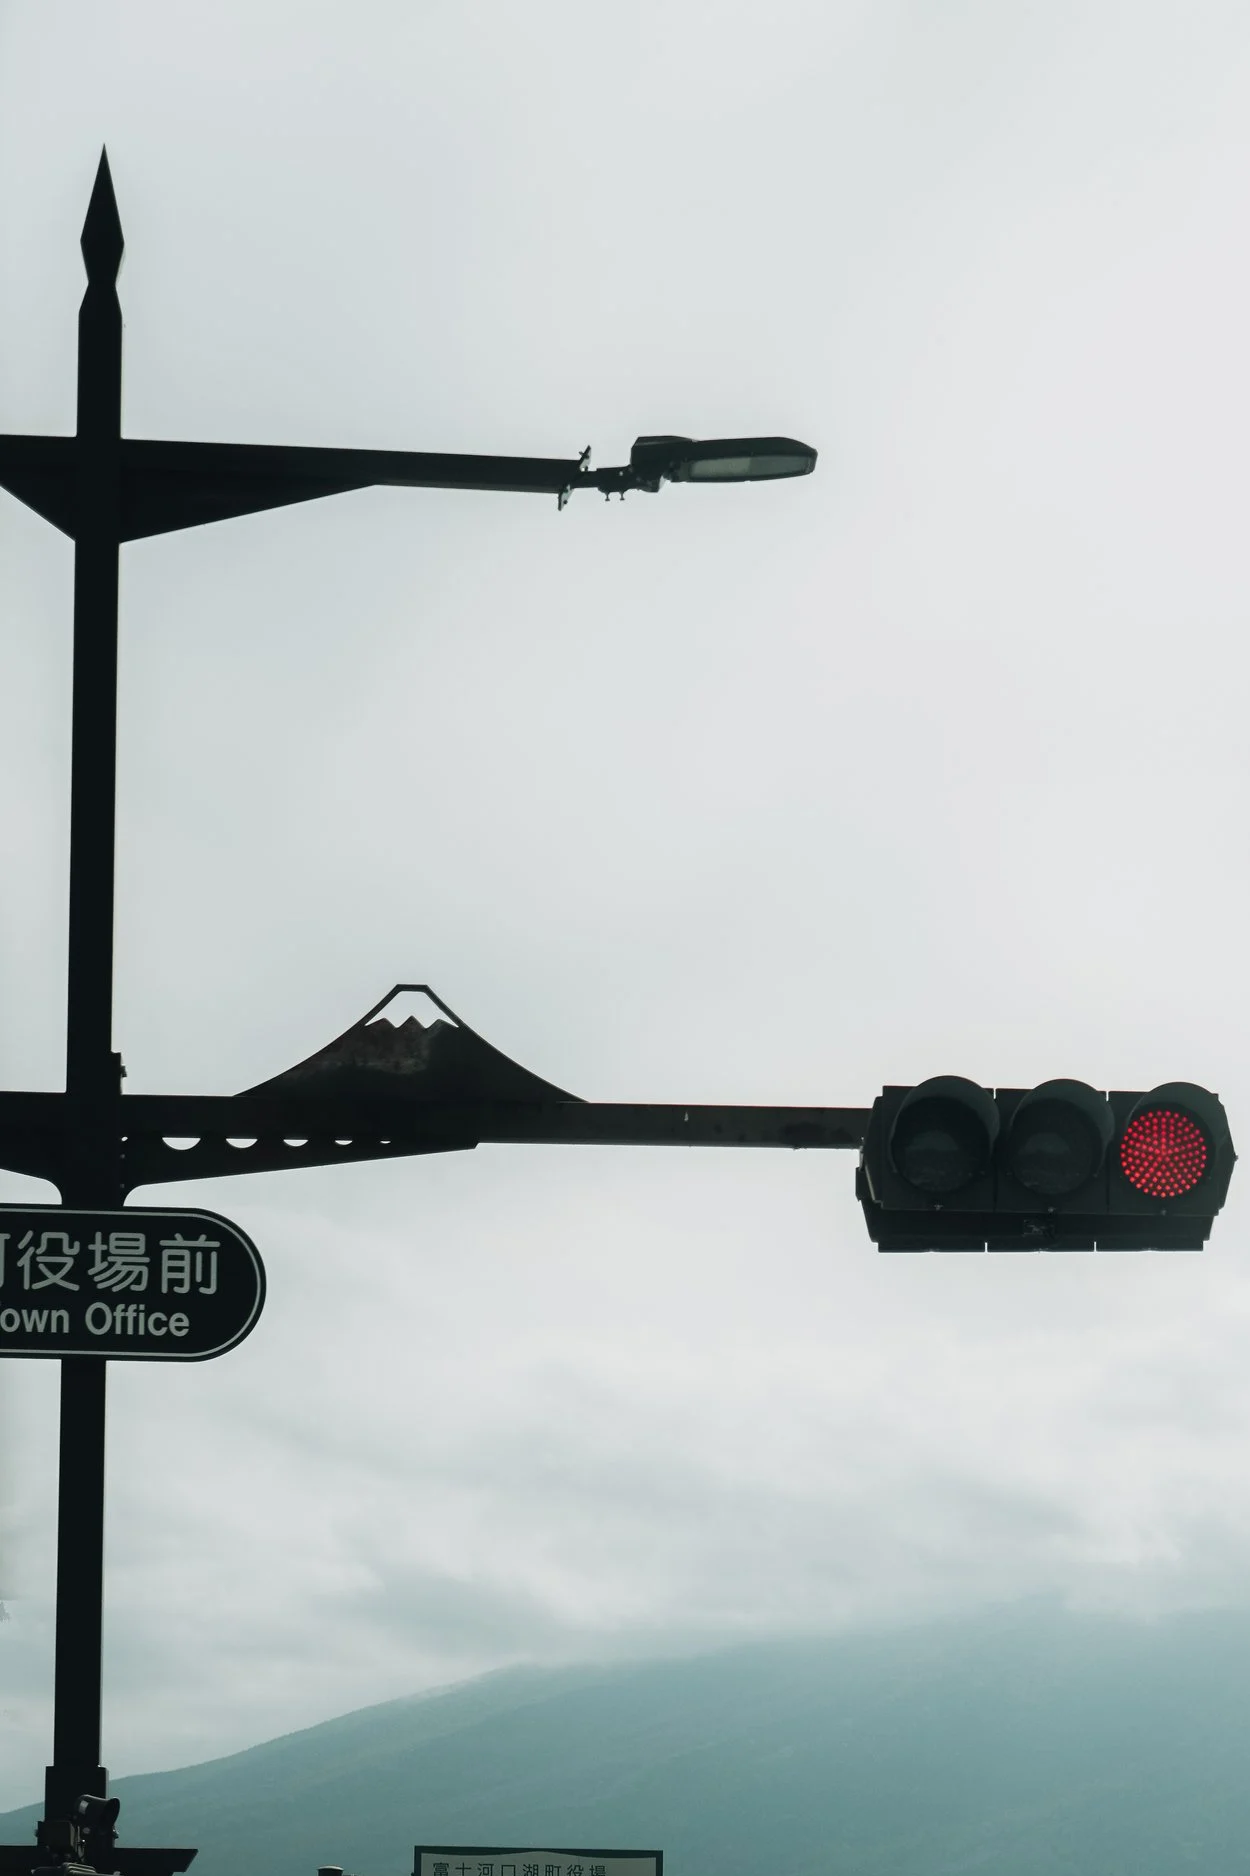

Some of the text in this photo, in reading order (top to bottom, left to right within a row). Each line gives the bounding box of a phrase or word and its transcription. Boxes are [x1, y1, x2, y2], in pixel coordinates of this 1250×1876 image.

[0, 1230, 221, 1295] 役場前
[85, 1302, 190, 1337] Office
